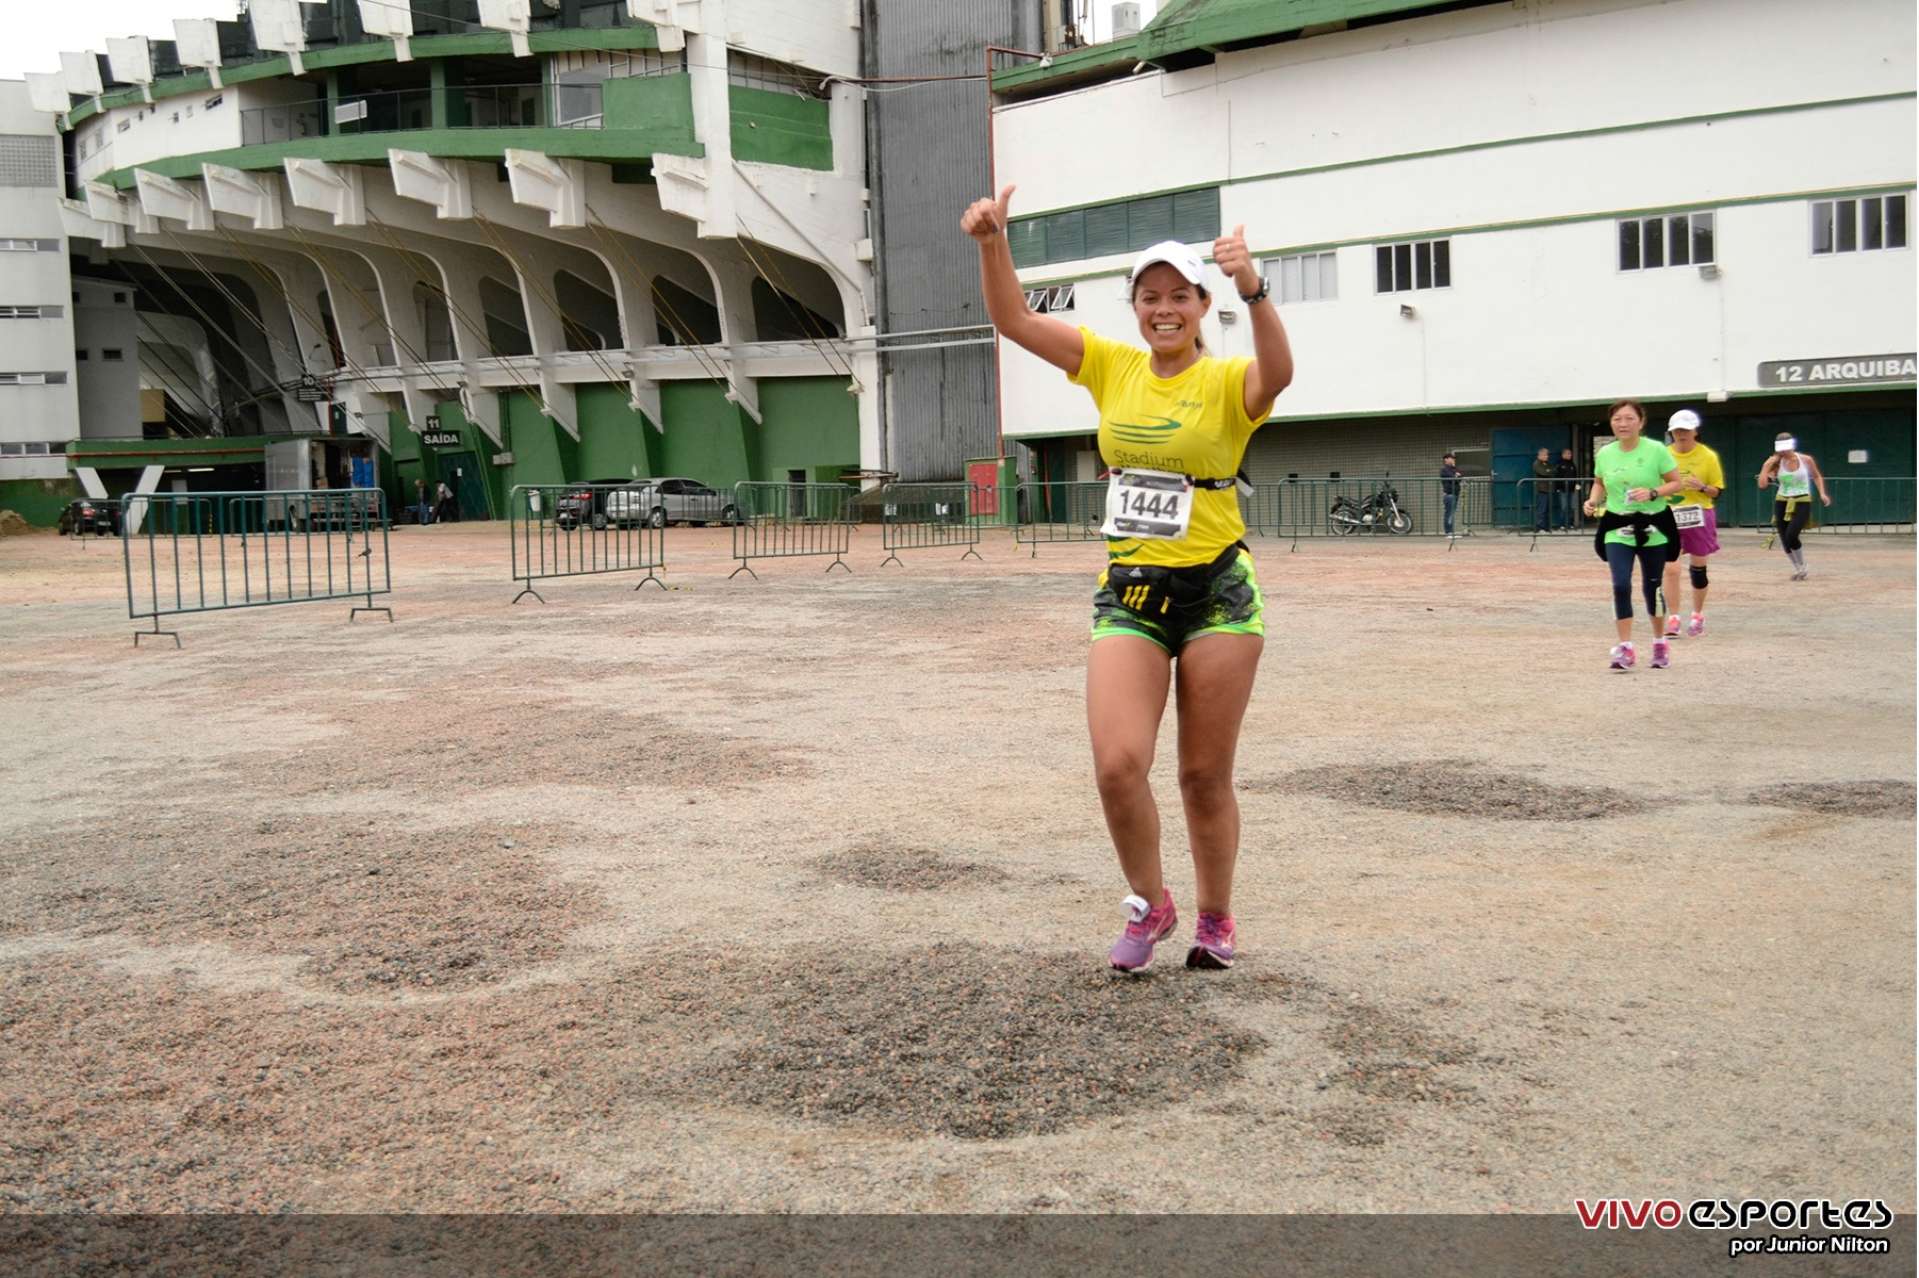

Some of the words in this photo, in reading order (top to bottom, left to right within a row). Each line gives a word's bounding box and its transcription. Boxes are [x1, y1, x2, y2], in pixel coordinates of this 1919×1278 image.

[1775, 366, 1803, 382] 12
[1808, 359, 1917, 381] ARQUIBA
[428, 418, 440, 429] 11
[424, 432, 459, 444] SAÍDA
[1113, 449, 1185, 469] Stadium
[1120, 489, 1179, 519] 1444
